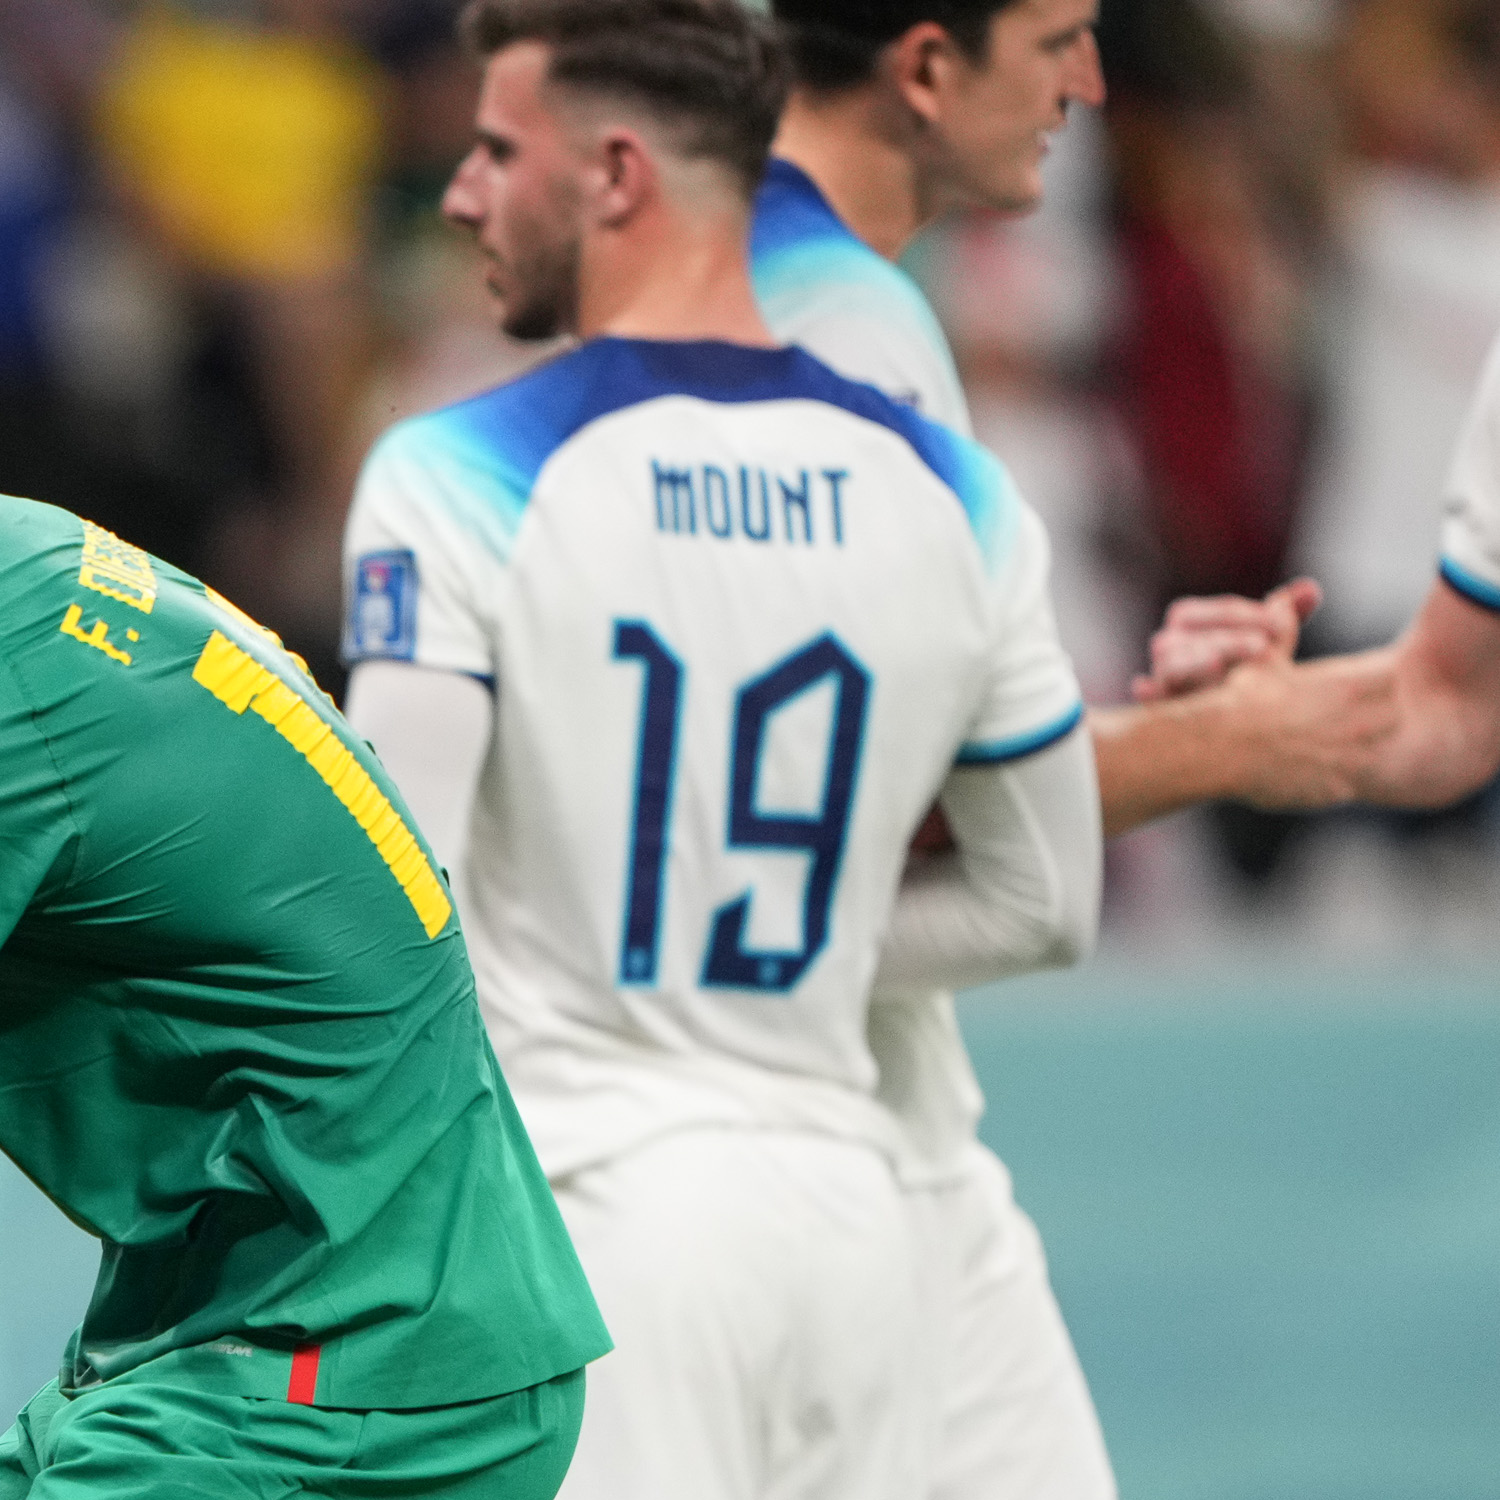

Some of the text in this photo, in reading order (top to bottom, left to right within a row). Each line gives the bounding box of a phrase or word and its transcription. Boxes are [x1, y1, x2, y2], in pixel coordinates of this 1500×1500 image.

[650, 457, 853, 546] MOUNT
[60, 603, 140, 667] F.
[611, 616, 874, 994] 19
